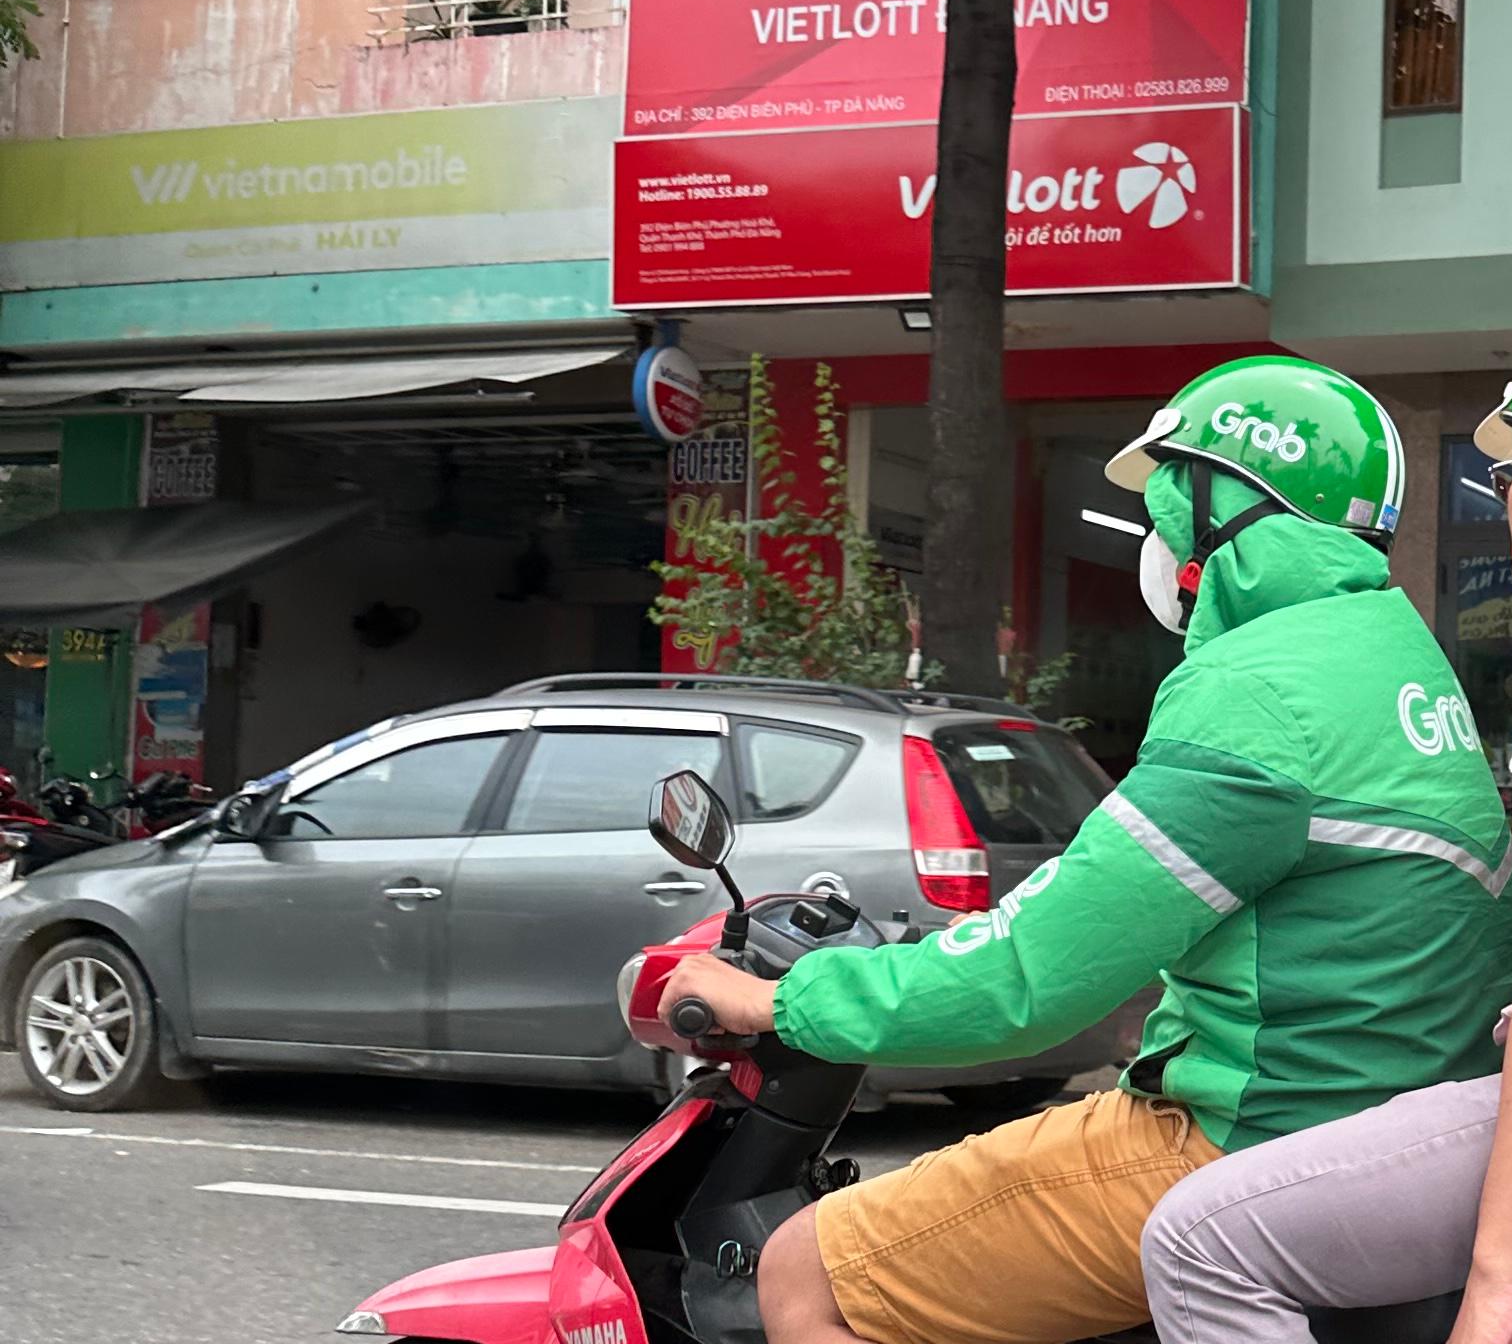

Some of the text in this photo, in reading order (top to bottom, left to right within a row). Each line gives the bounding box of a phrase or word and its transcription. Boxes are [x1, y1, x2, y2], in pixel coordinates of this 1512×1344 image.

[1045, 86, 1079, 104] ĐIỆN
[1081, 83, 1125, 102] THOẠI
[690, 108, 714, 122] 392
[824, 99, 843, 114] TP
[203, 143, 467, 199] vietnamobile
[637, 173, 732, 188] www.vietlott.vn
[637, 189, 686, 203] Hotline:
[899, 165, 1105, 220] Vlott
[1026, 223, 1049, 245] để
[1053, 223, 1081, 244] tốt
[1084, 225, 1123, 243] hơn
[1210, 400, 1308, 464] Grab
[672, 438, 746, 485] COFFEE
